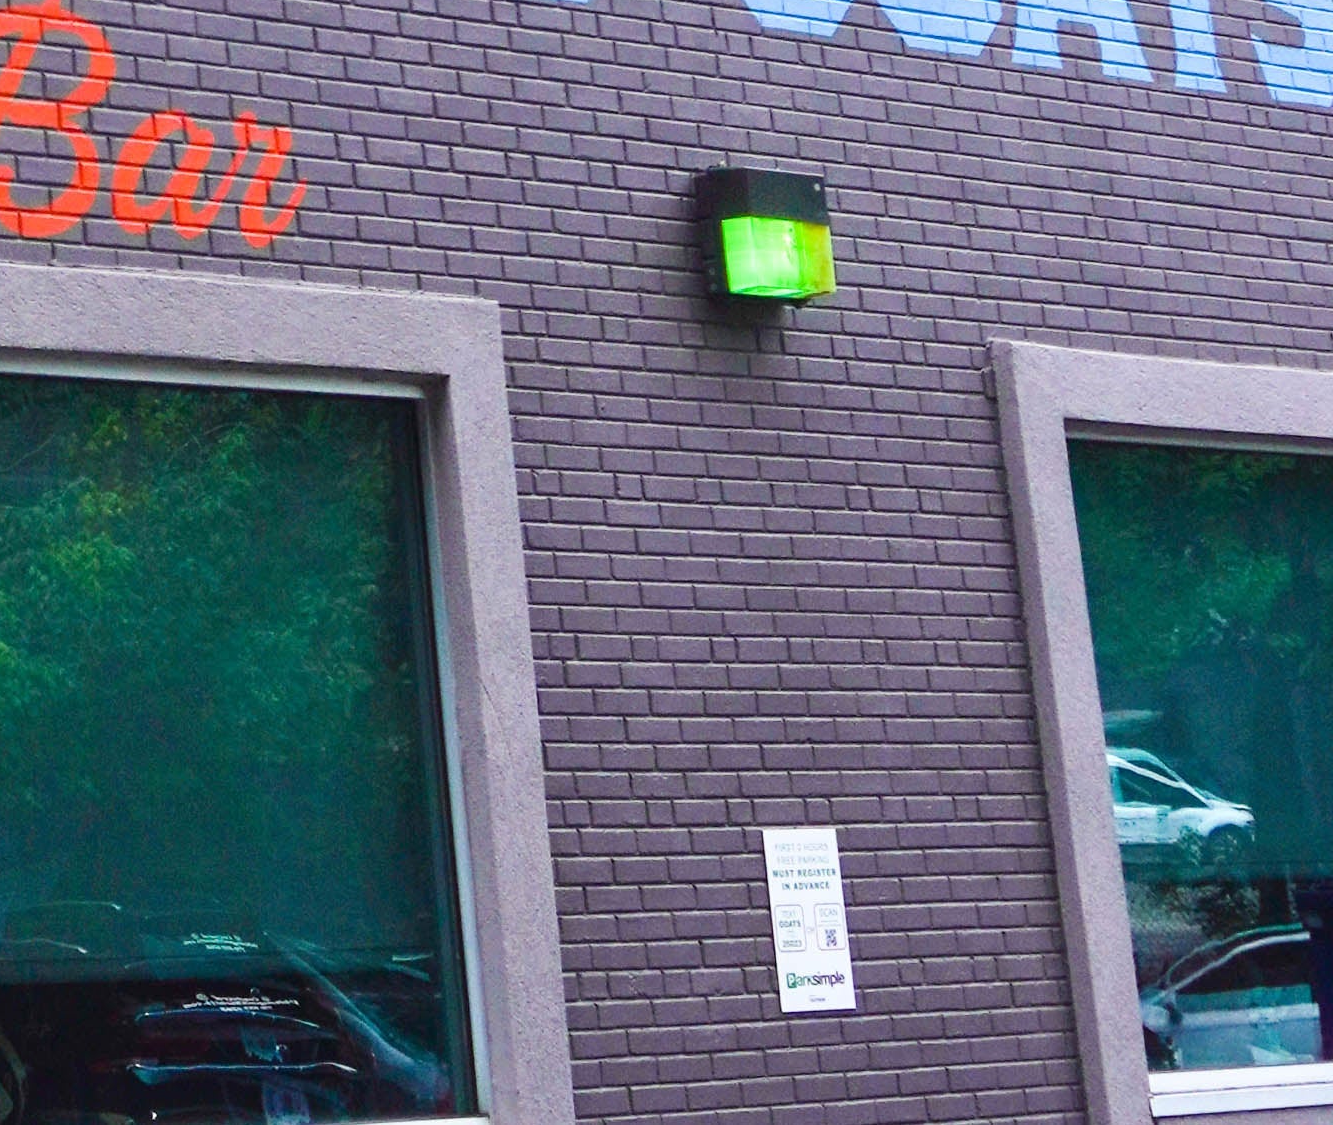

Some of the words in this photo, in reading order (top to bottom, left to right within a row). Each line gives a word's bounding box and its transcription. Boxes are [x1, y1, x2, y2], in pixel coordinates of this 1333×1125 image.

[772, 869, 794, 878] MUST
[797, 868, 836, 878] REGISTER
[793, 881, 830, 891] ADVANCE
